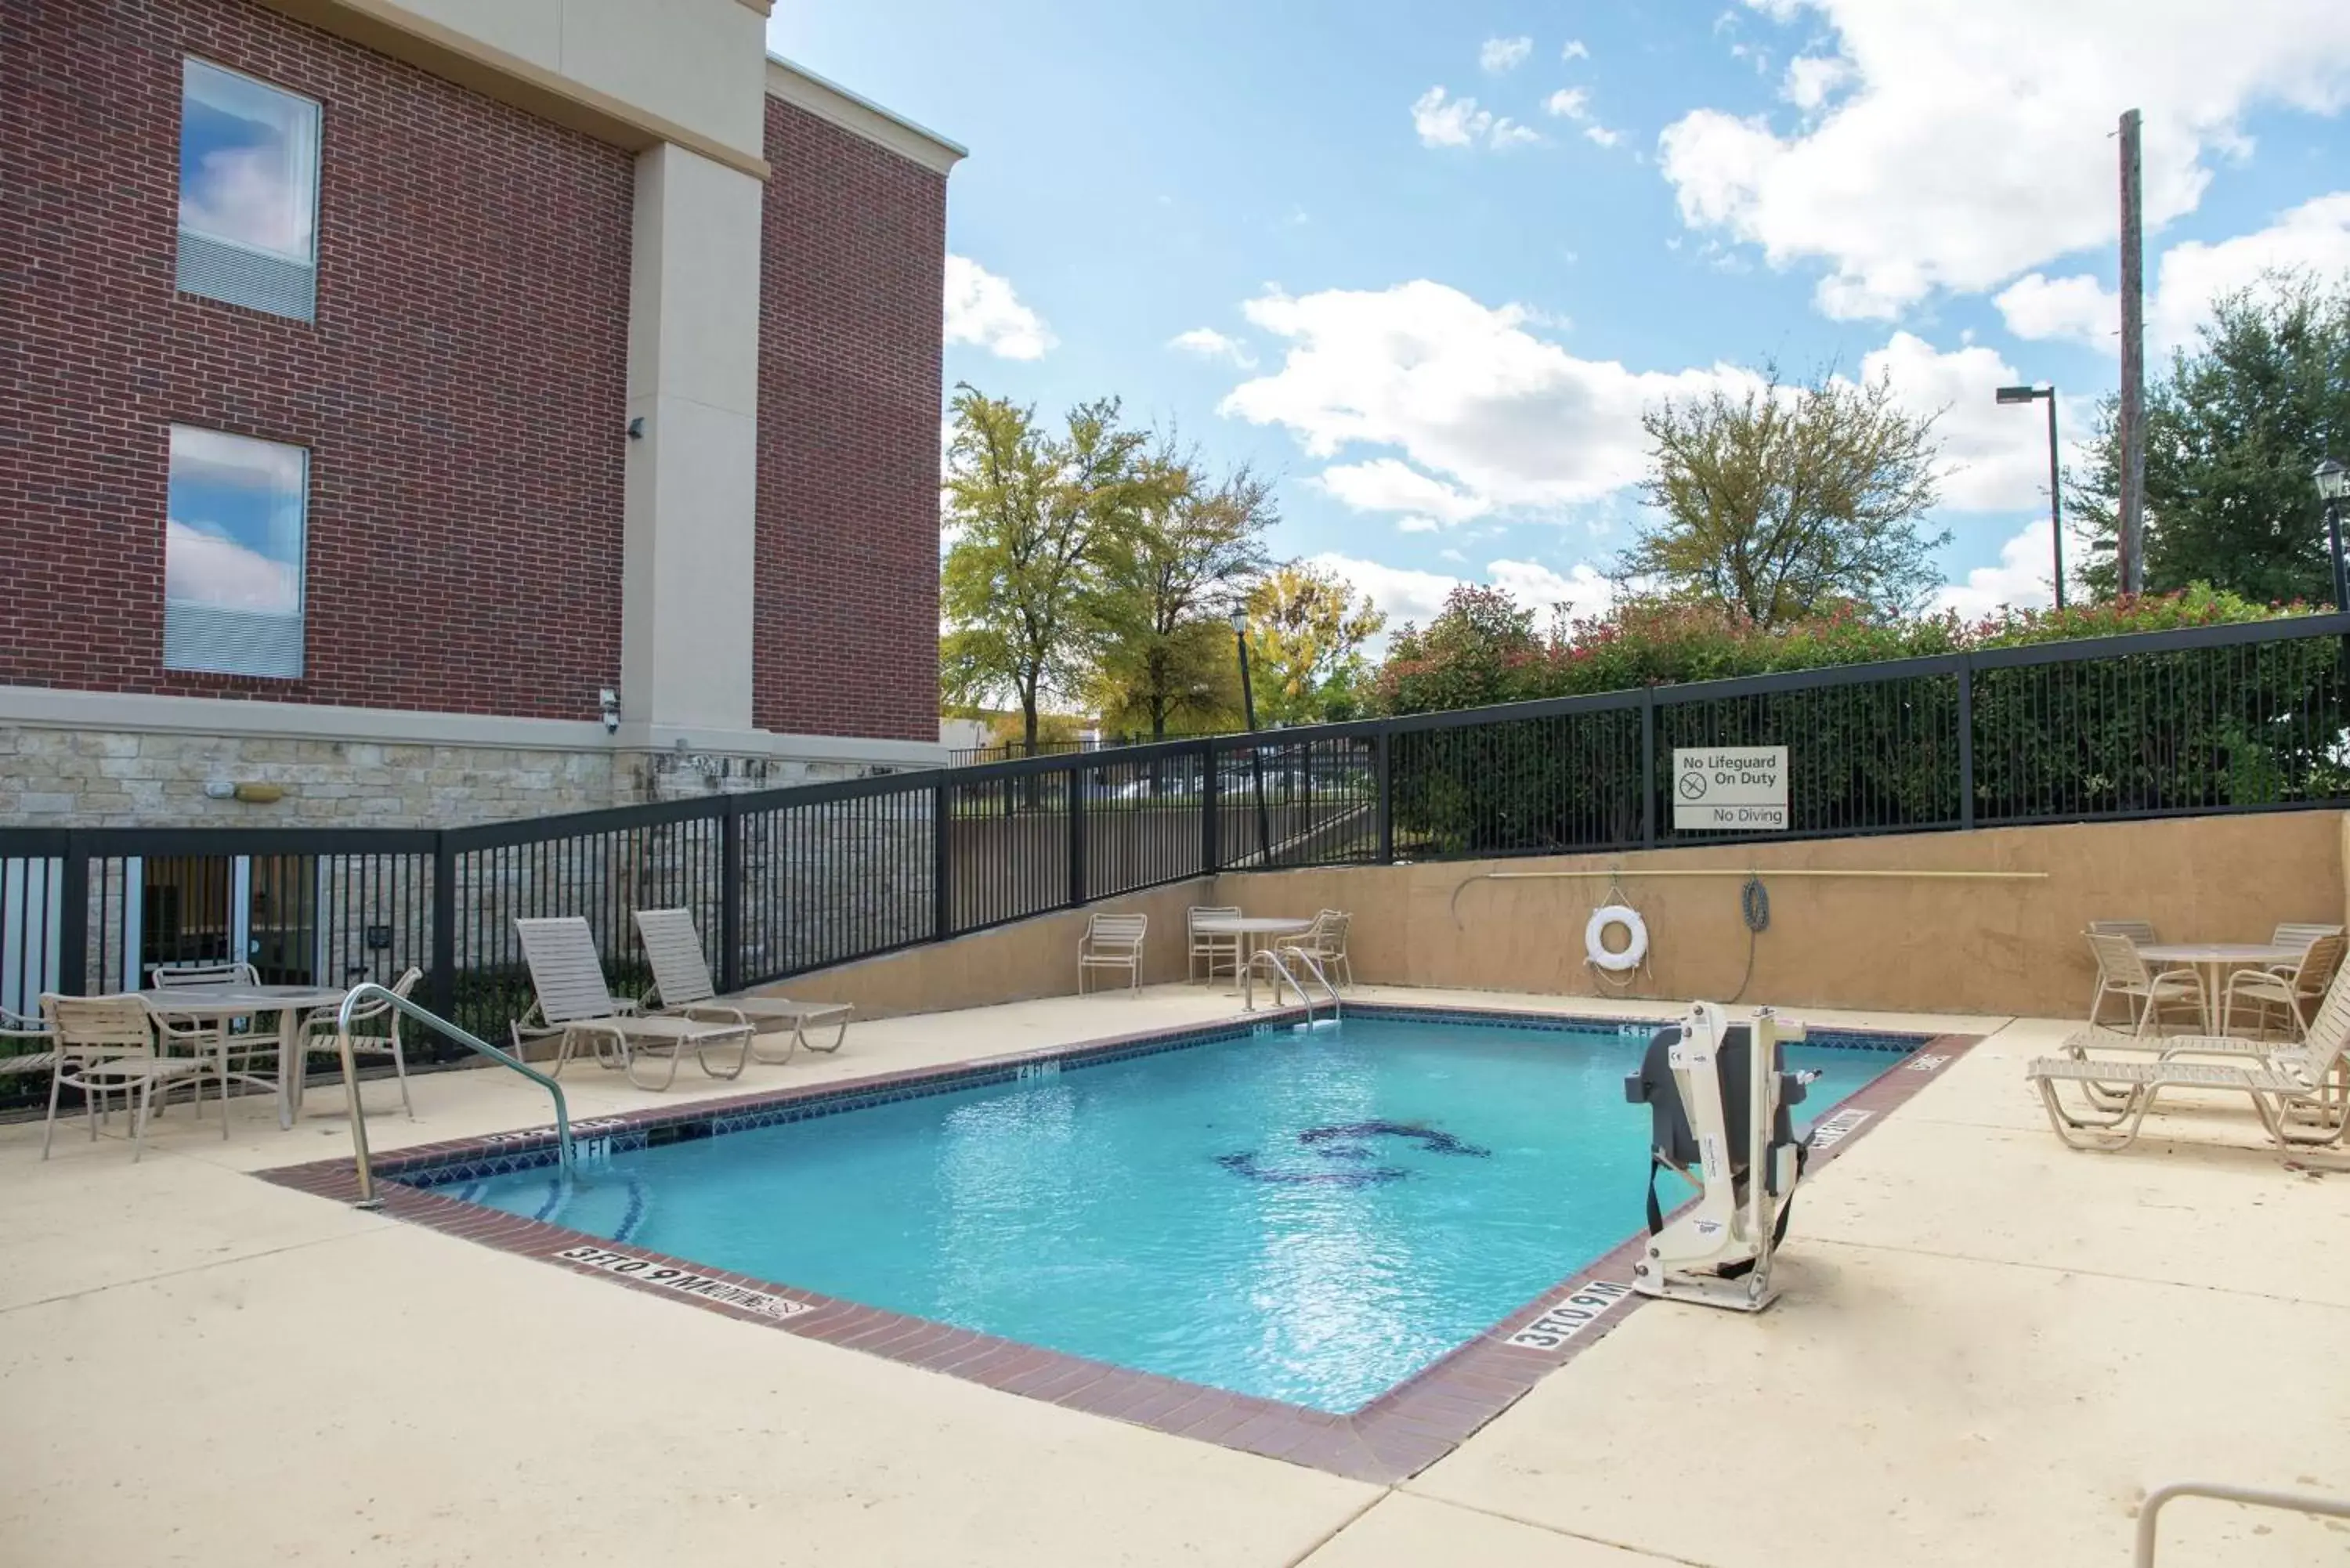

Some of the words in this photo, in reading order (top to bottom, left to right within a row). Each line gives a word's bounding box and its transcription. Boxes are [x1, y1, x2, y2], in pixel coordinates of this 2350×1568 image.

[1683, 757, 1704, 768] No
[1708, 755, 1776, 771] Lifeguard
[1715, 772, 1735, 784] On
[1741, 772, 1777, 787] Duty
[1714, 808, 1734, 821] No
[1738, 808, 1782, 824] Diving
[589, 1139, 604, 1157] FT
